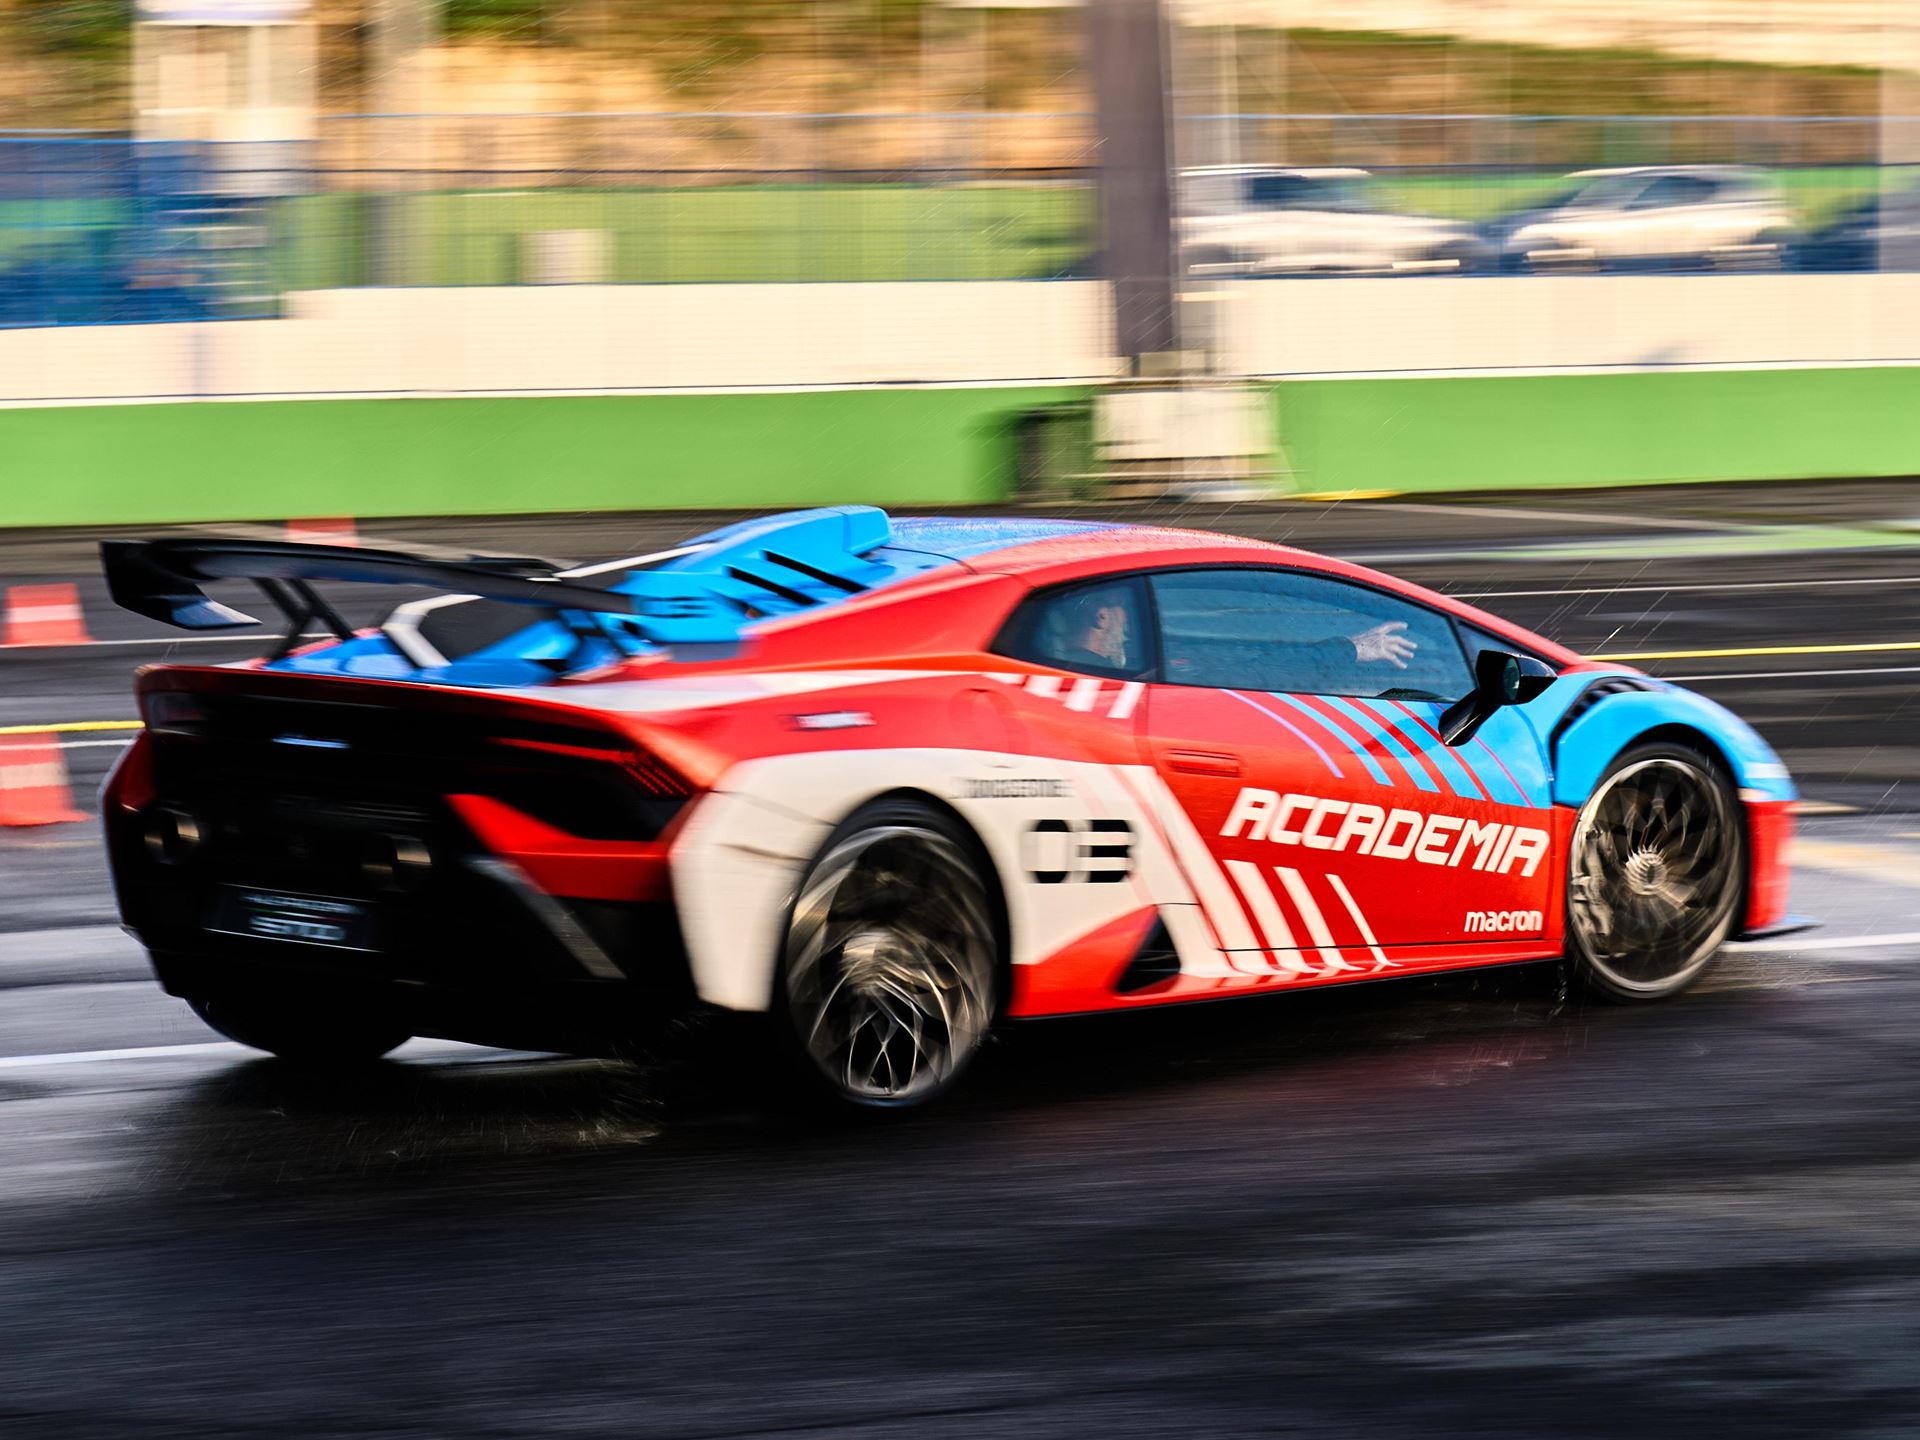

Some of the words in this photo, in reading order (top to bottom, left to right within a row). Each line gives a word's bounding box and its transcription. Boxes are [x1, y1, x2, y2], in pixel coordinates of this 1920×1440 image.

[1020, 818, 1137, 884] 03
[1219, 787, 1550, 877] ACCADEMIA
[1463, 909, 1543, 933] macron
